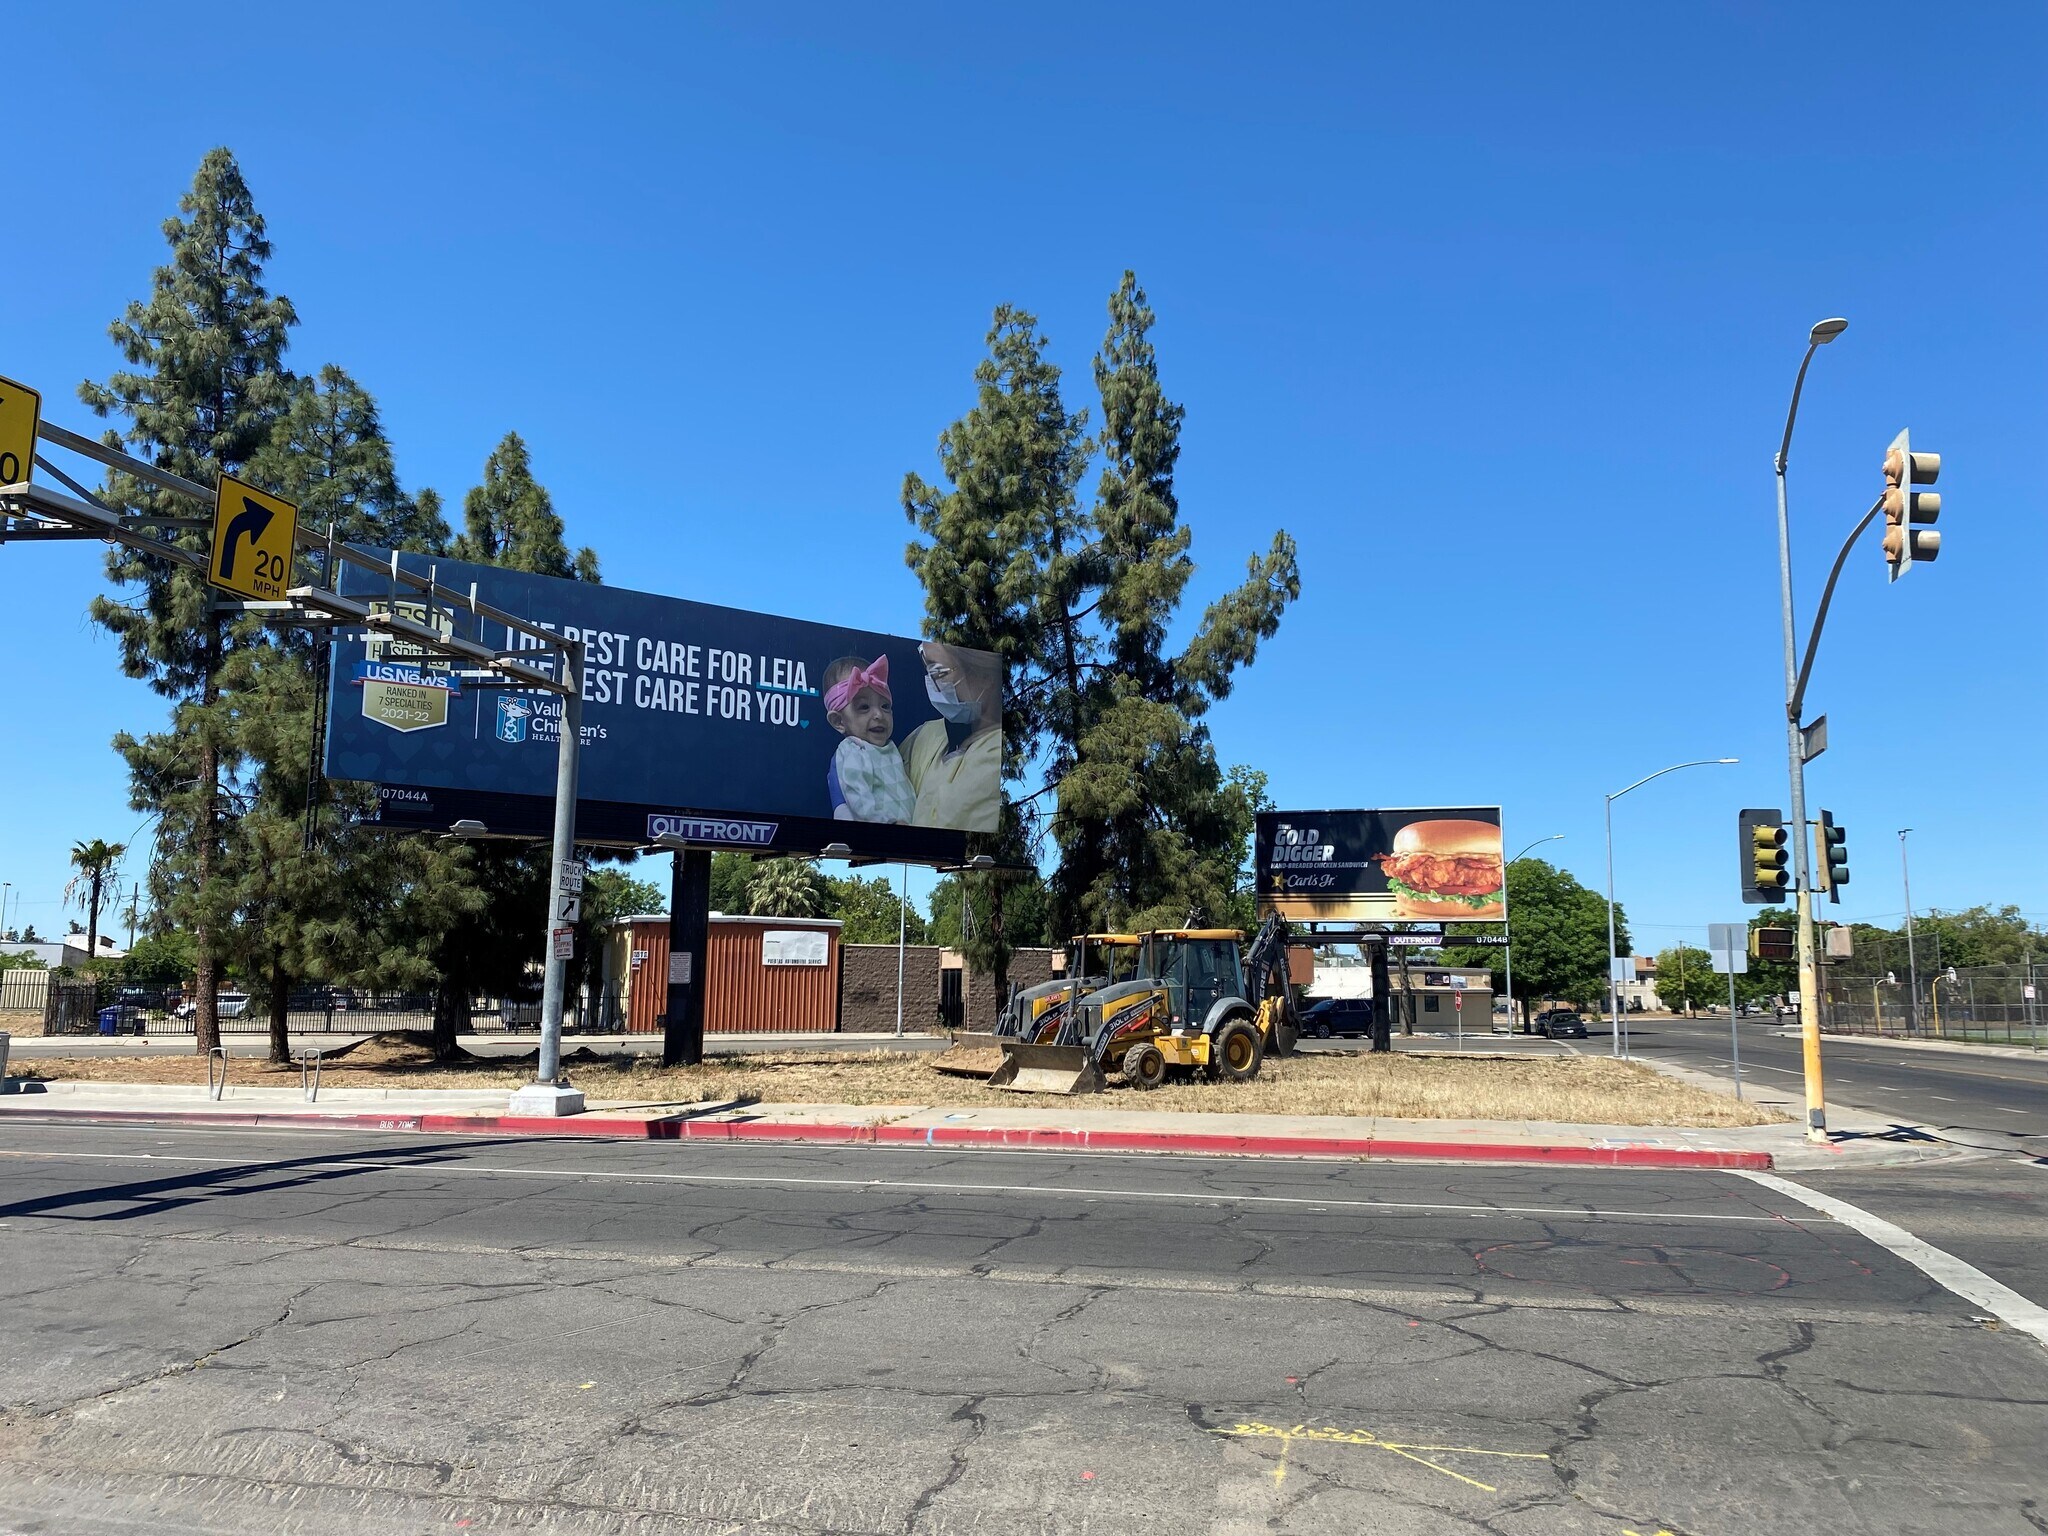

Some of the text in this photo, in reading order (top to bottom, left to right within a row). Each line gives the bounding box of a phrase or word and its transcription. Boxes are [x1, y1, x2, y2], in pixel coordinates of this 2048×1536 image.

[254, 550, 284, 582] 20
[253, 579, 280, 597] MPH
[636, 637, 701, 678] CARE
[707, 648, 752, 685] FOR
[759, 656, 816, 693] LEIA.
[386, 686, 427, 699] RANKED IN
[582, 667, 628, 704] EST
[635, 675, 700, 715] CARE
[706, 685, 750, 721] FOR
[756, 691, 800, 727] YOU
[379, 696, 433, 710] 7 SPECIALTIES
[532, 700, 561, 718] Vall
[381, 707, 429, 722] 2021-22
[531, 717, 608, 739] Chilen's
[531, 733, 592, 746] HEALTRE
[382, 788, 428, 802] 07044A
[652, 817, 771, 842] OUTFRONT
[1275, 829, 1320, 845] GOLD
[1271, 845, 1335, 862] DIGGER
[562, 863, 582, 876] TRUCK
[561, 876, 581, 888] ROUTE
[1287, 874, 1318, 888] Carl's
[1393, 936, 1508, 944] OUTFRONT 07044B
[1108, 1017, 1124, 1030] 310L
[380, 1120, 394, 1129] BUS
